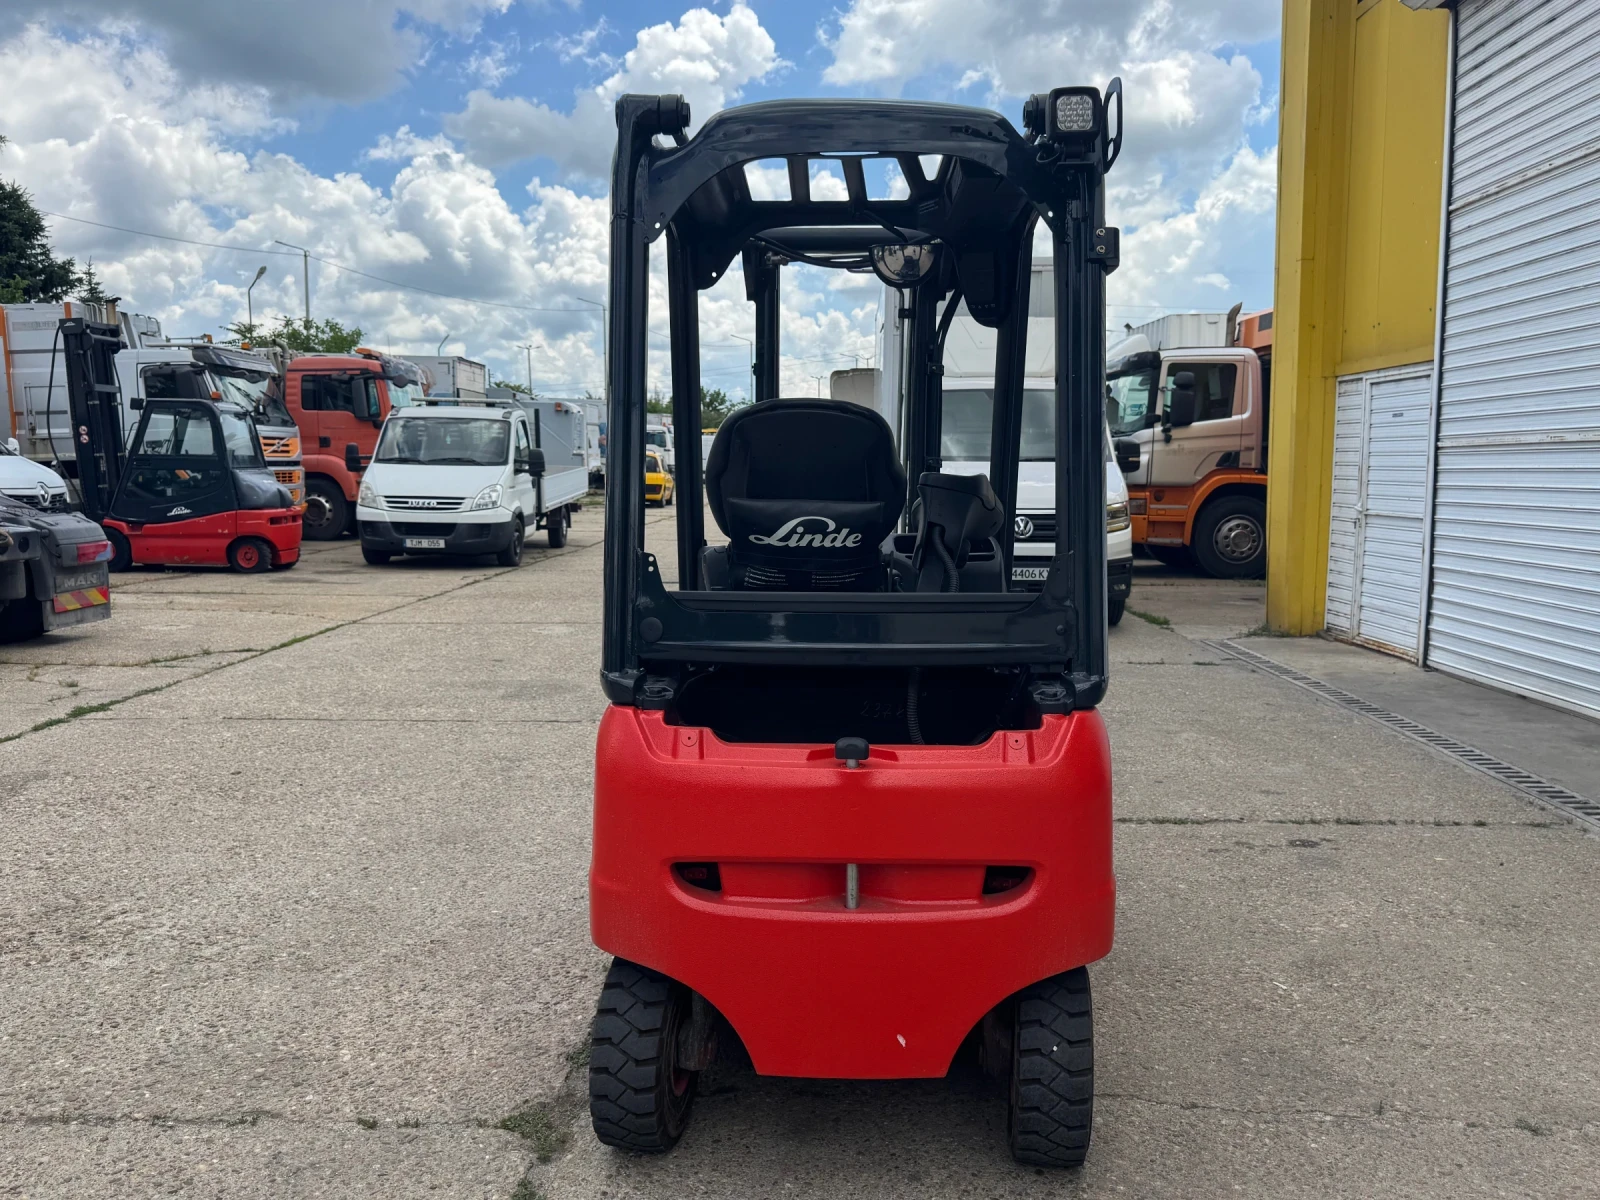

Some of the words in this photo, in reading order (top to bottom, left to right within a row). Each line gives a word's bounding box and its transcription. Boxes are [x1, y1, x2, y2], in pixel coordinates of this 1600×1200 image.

[748, 516, 862, 547] Linde
[64, 574, 97, 587] MAN
[1012, 569, 1036, 579] 4406
